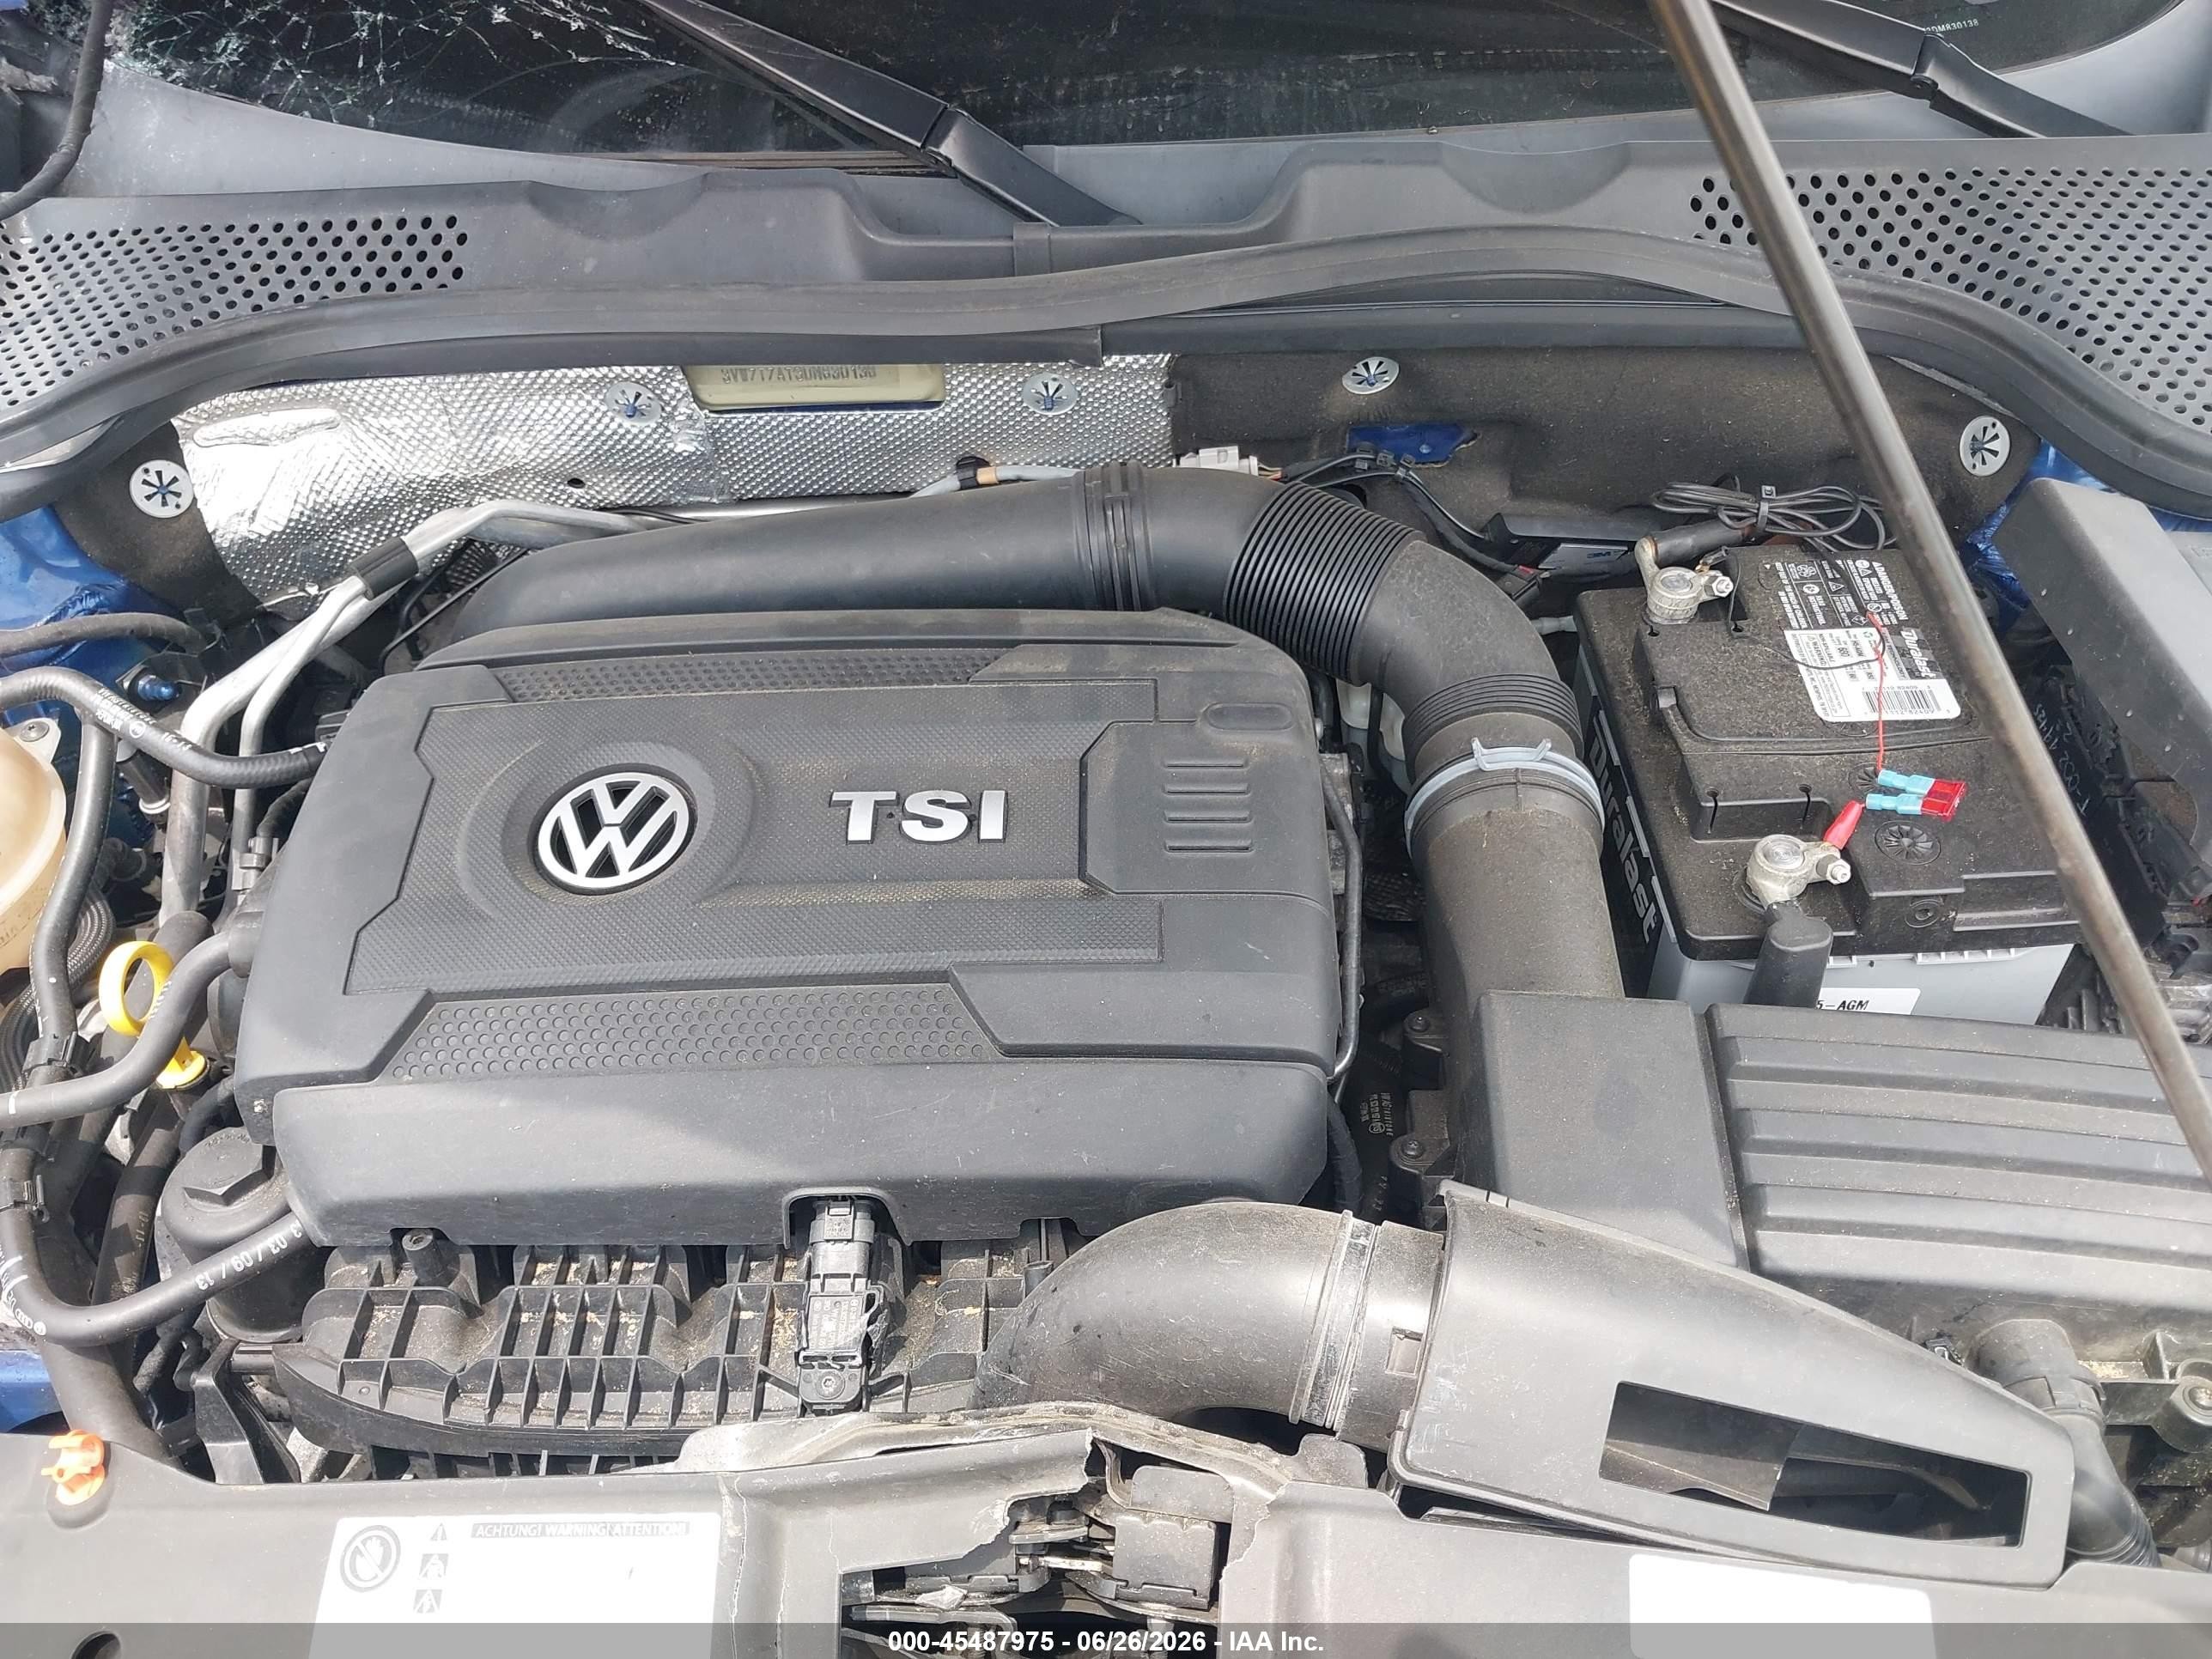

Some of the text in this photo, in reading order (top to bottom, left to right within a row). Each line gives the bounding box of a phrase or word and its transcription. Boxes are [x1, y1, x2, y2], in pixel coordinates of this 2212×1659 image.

[1875, 567, 1908, 619] DANGER/POISON
[1900, 629, 1936, 678] Duralast
[830, 790, 1008, 844] TSI
[1589, 716, 1657, 944] Duralast
